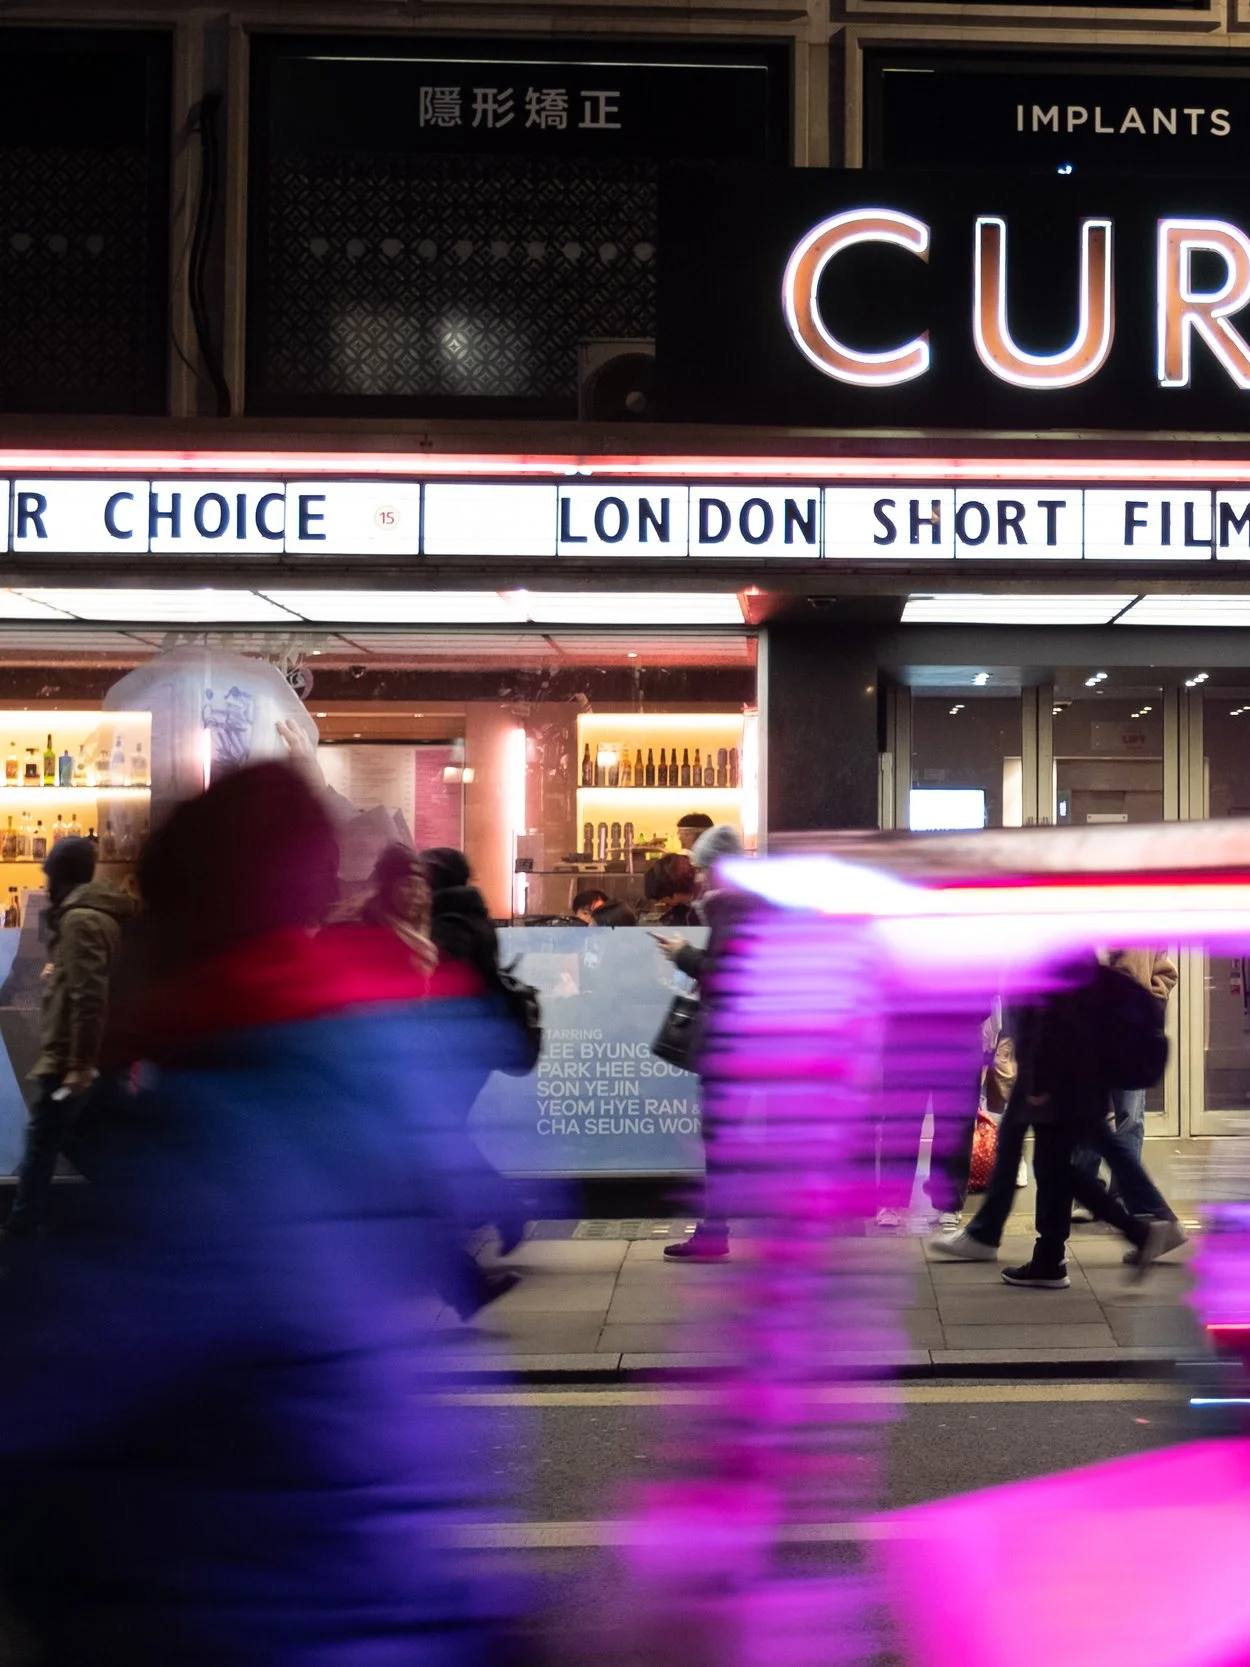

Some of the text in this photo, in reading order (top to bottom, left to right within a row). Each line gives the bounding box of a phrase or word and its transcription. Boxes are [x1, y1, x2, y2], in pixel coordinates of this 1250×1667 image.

[419, 86, 622, 130] 隱形矯正
[1016, 104, 1232, 137] IMPLANTS
[16, 491, 327, 541] R CHOICE
[379, 510, 395, 525] 15
[559, 496, 818, 545] LONDON
[873, 498, 1067, 546] SHORT
[580, 1041, 650, 1059] BYUNG
[537, 1060, 699, 1078] PARK HEE SOO
[537, 1080, 640, 1097] SON YEJIN
[537, 1099, 595, 1116] YEOM
[600, 1099, 640, 1116] HYE
[644, 1099, 688, 1115] RAN
[536, 1117, 580, 1135] CHA
[584, 1117, 655, 1135] SEUNG
